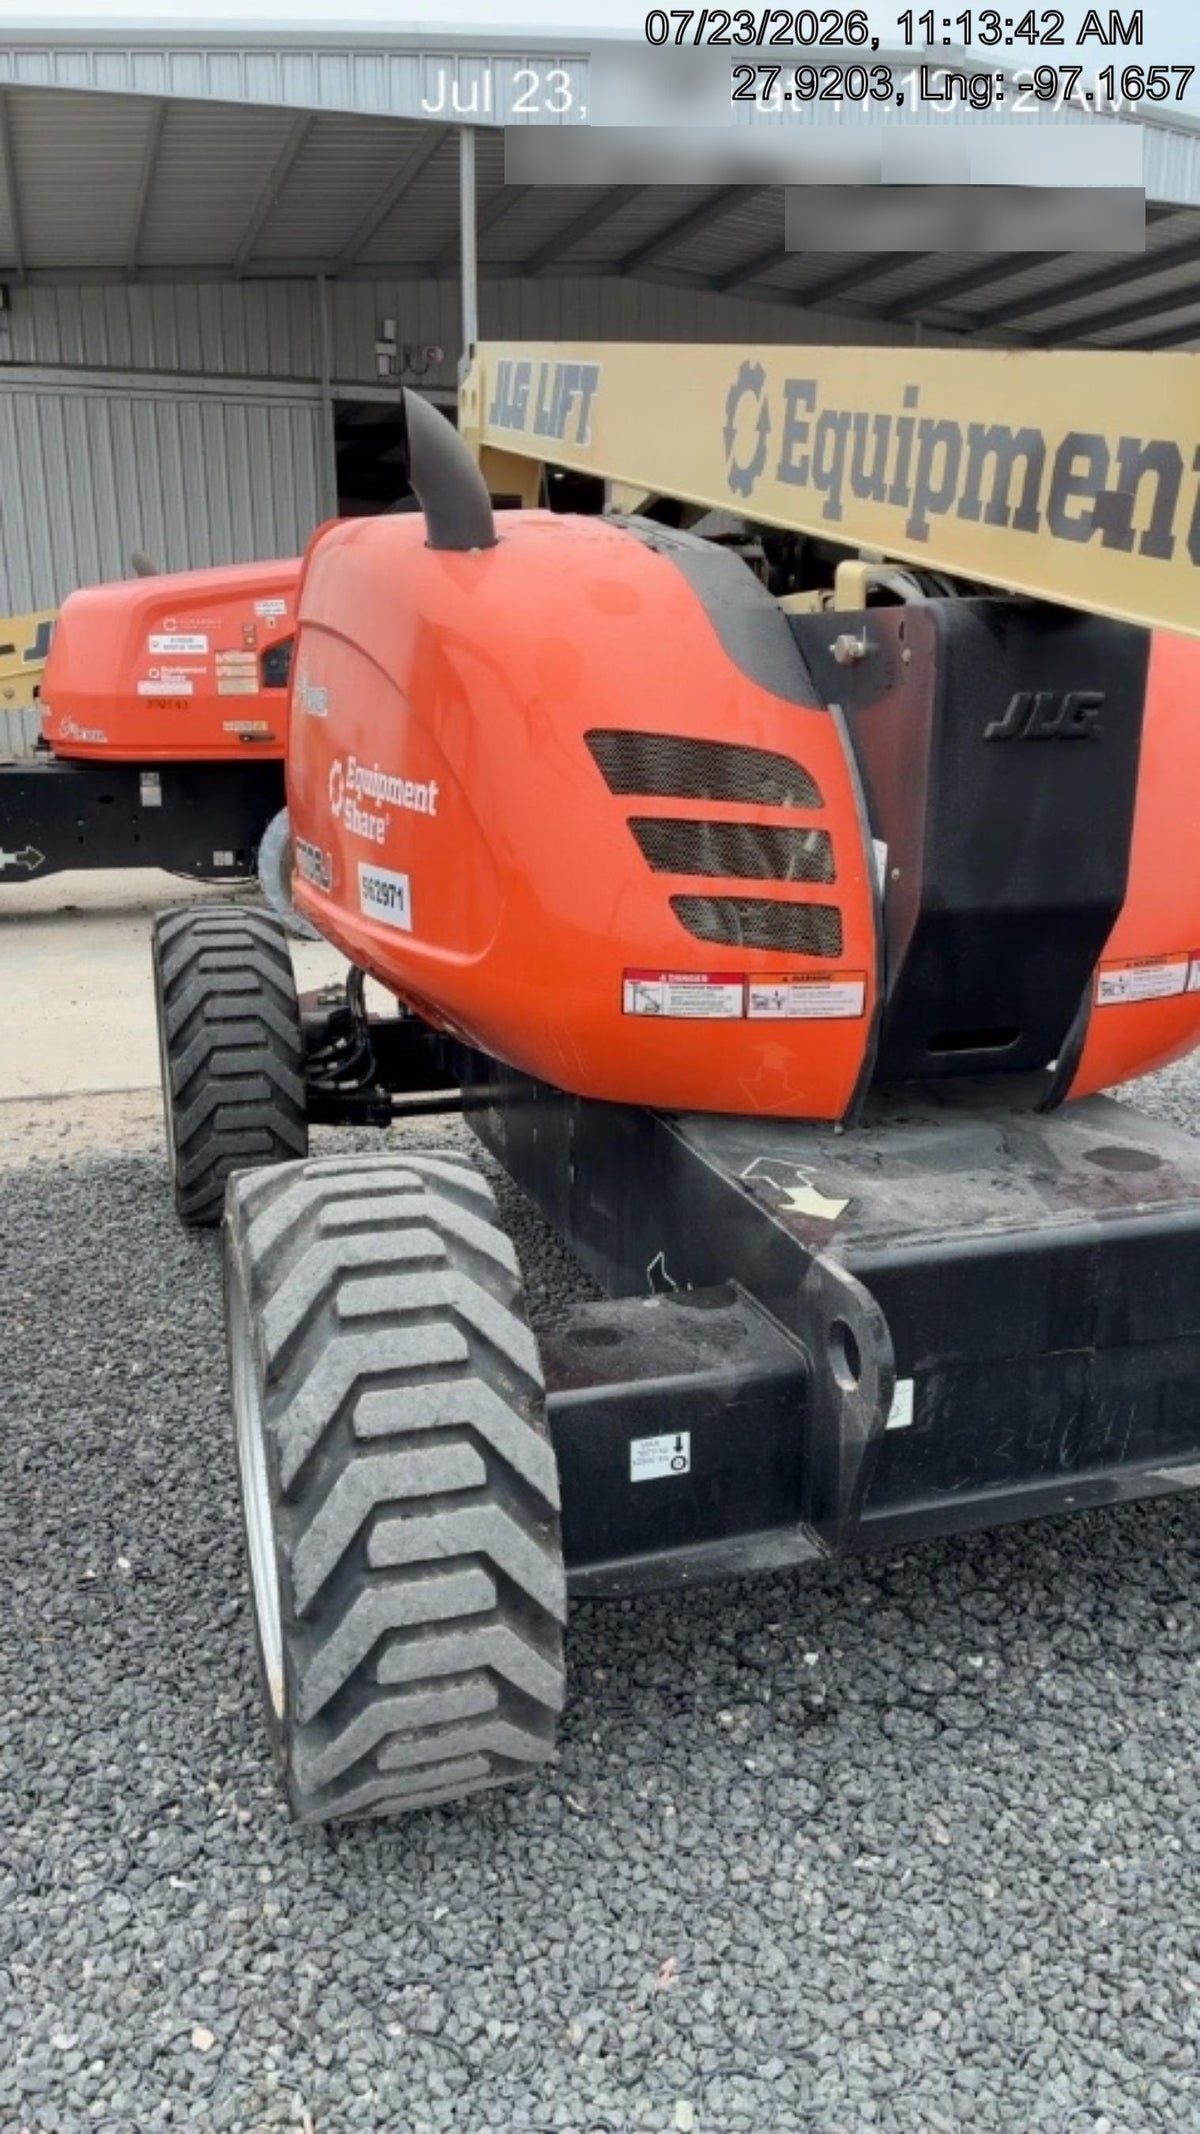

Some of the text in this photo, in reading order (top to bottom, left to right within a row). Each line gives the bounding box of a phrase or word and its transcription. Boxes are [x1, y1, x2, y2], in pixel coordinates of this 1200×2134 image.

[488, 360, 601, 446] JLG LIFT
[776, 378, 1200, 568] Equipmen
[984, 691, 1105, 741] JLG
[346, 755, 439, 817] Equipment
[344, 798, 386, 845] Share
